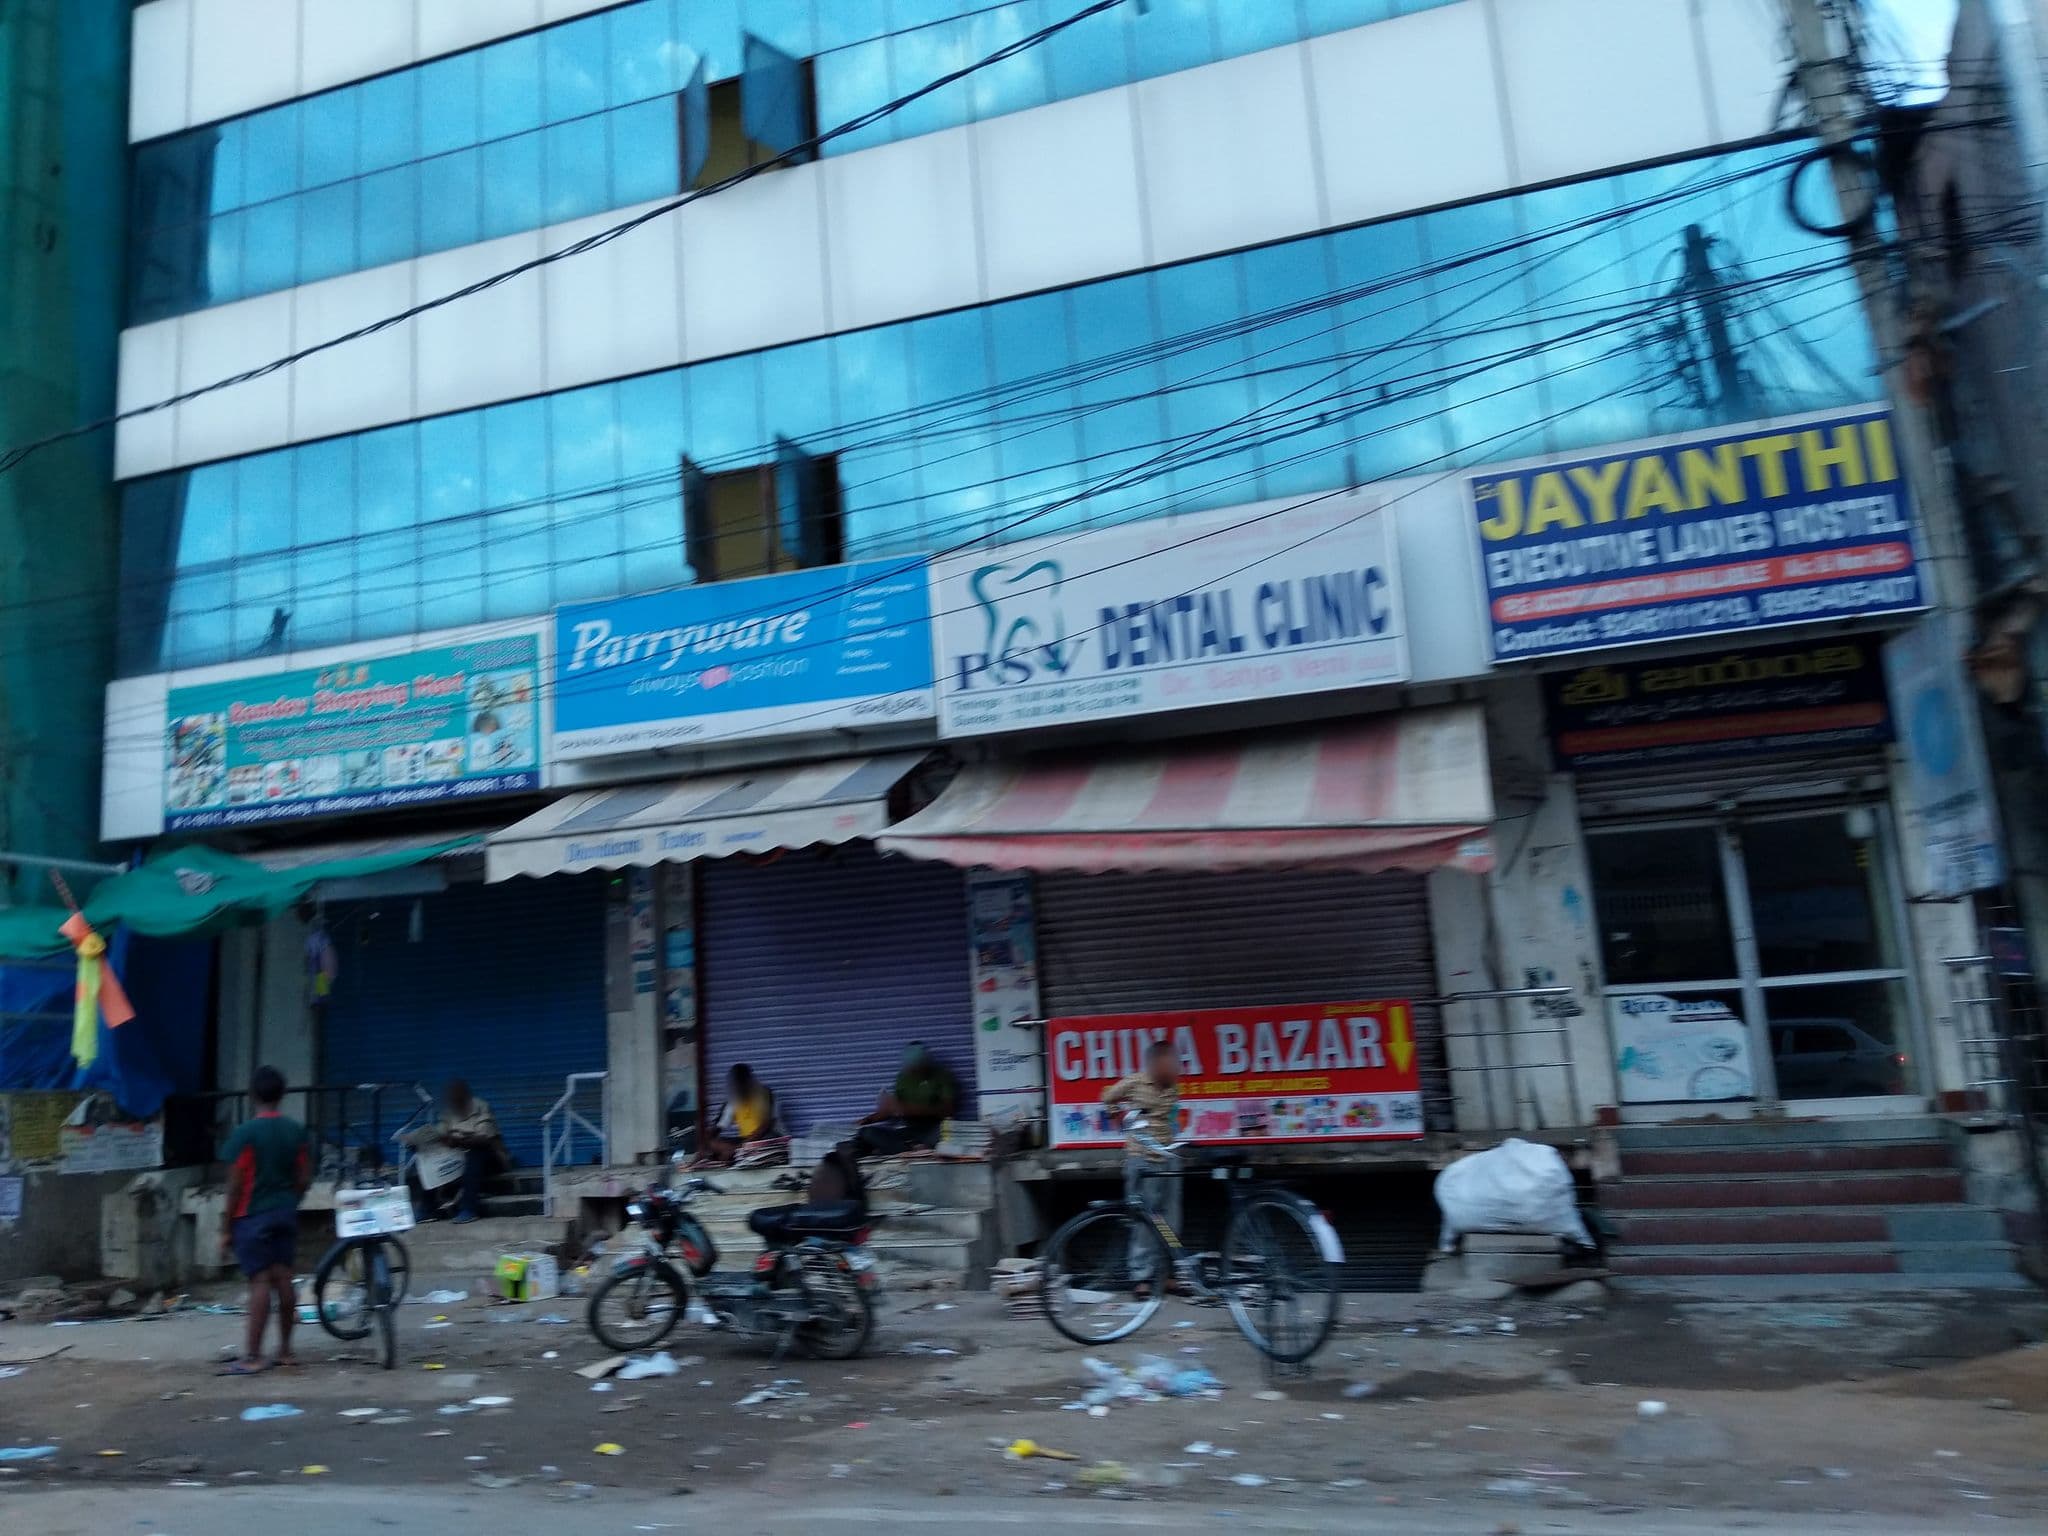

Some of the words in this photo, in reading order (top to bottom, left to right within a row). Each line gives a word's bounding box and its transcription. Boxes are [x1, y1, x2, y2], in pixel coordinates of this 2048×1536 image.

[1480, 418, 1898, 542] JAYANTHI
[1488, 527, 1657, 587] EXECUTIVE
[1659, 508, 1774, 566] LADIES
[1777, 494, 1905, 546] HOSTEL
[567, 608, 811, 672] Parryware
[1097, 589, 1247, 670] DENTAL
[1253, 565, 1390, 649] CLINIC
[312, 681, 408, 716] Shopping
[1216, 1016, 1386, 1076] BAZAR
